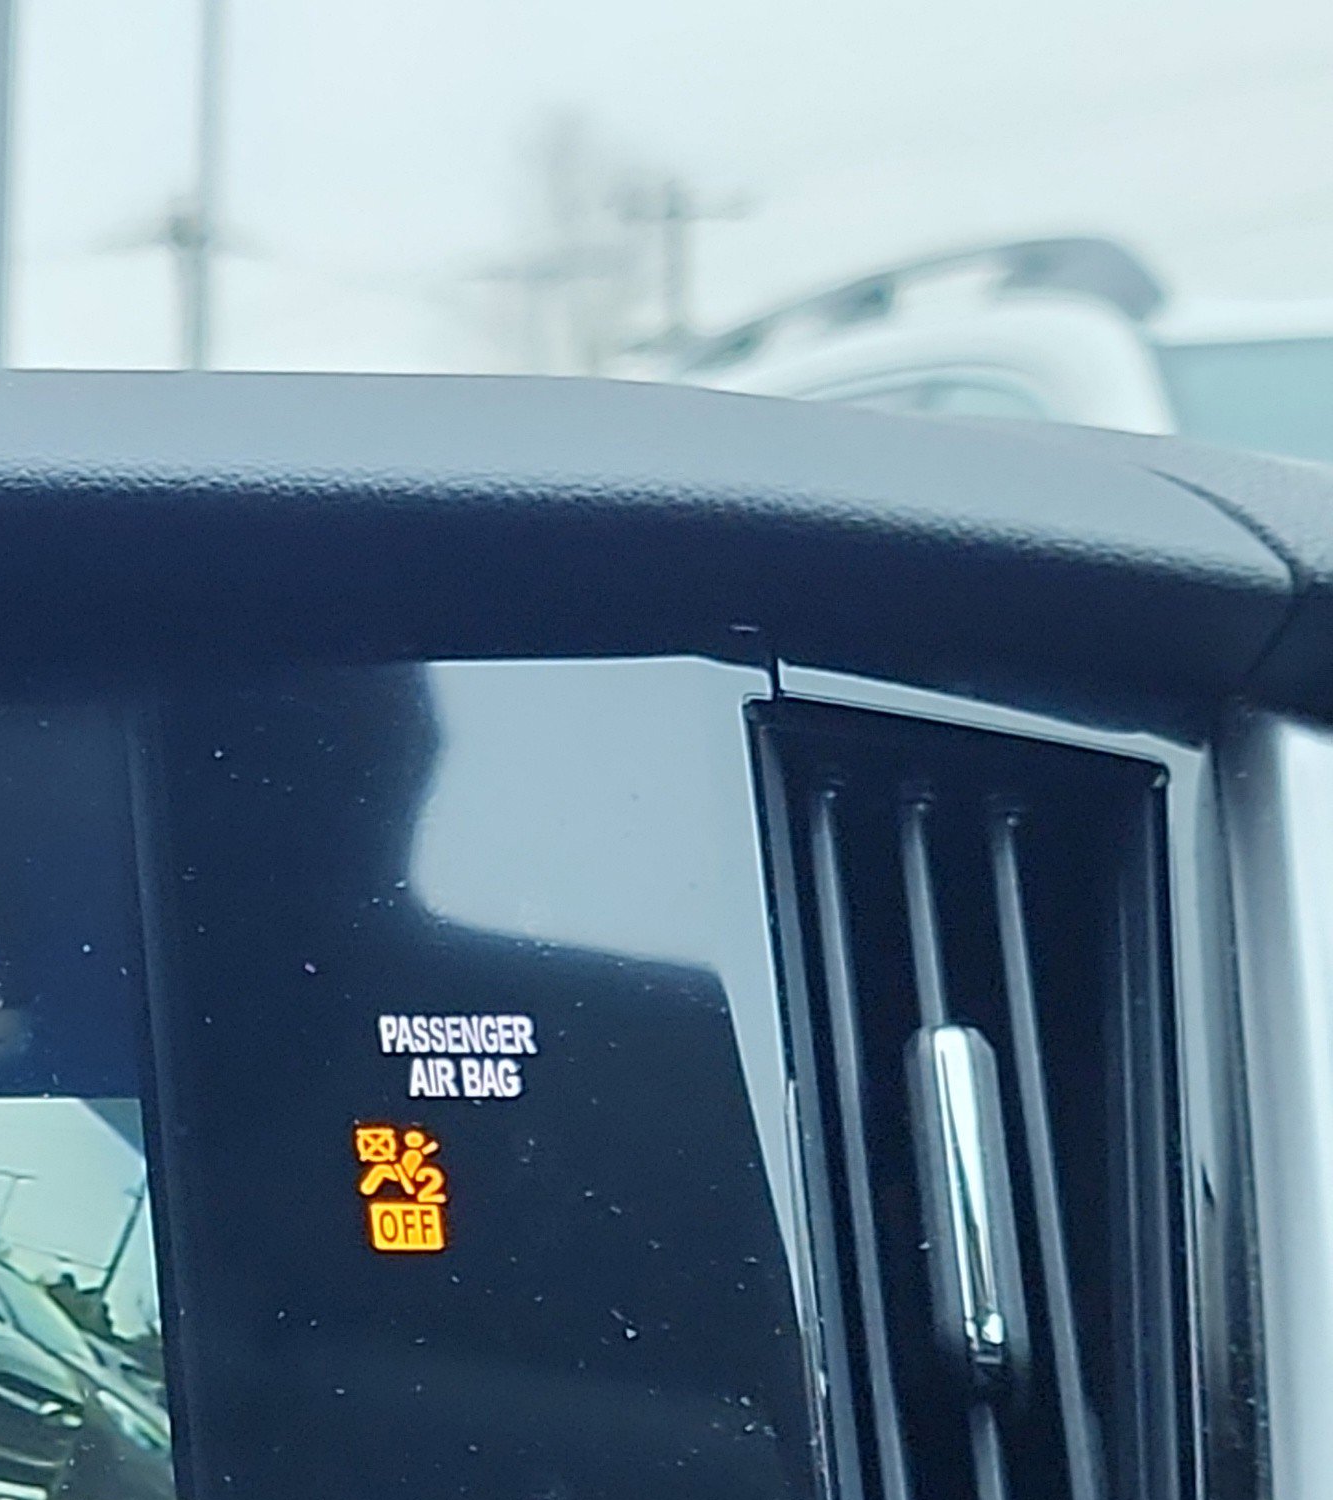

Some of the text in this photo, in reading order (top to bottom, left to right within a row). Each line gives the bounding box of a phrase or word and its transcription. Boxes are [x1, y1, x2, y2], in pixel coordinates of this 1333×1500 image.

[378, 1015, 537, 1054] PASSENGER
[409, 1058, 522, 1097] AIR BAG
[379, 1210, 433, 1244] OFF
